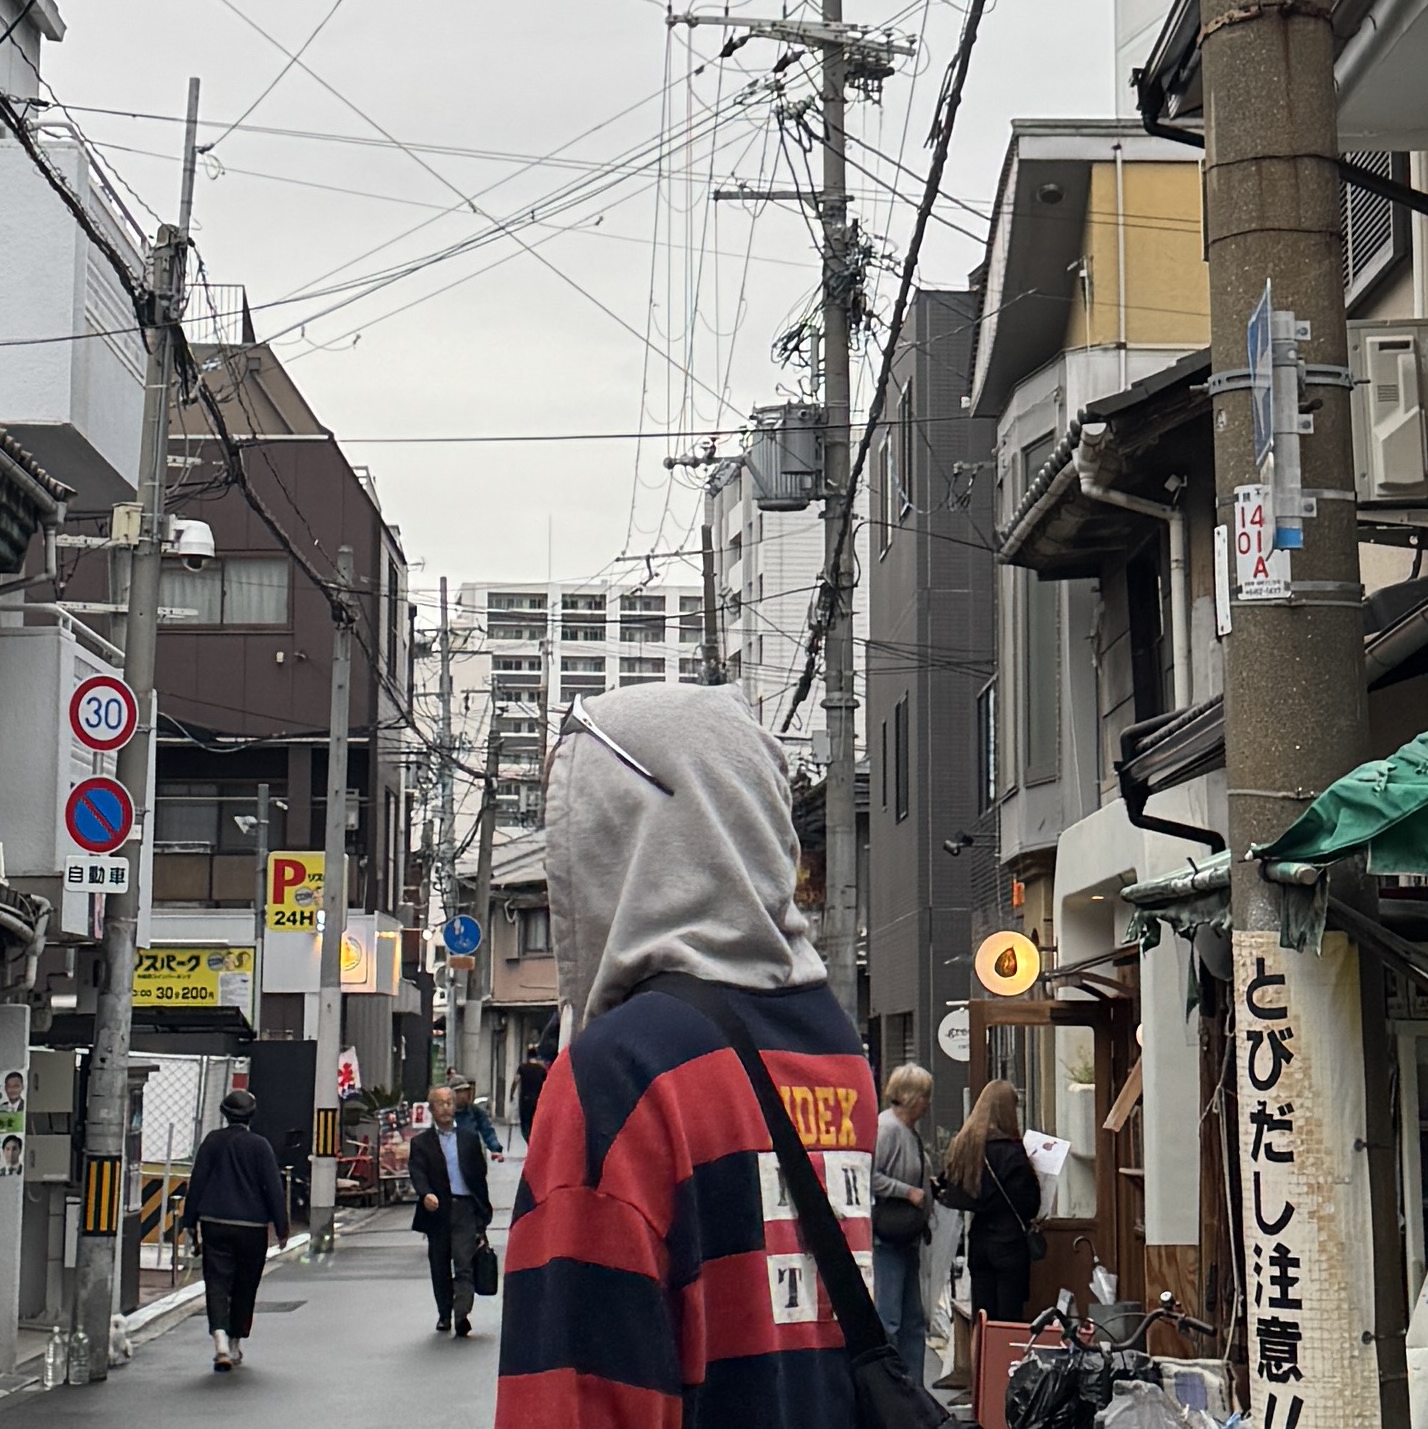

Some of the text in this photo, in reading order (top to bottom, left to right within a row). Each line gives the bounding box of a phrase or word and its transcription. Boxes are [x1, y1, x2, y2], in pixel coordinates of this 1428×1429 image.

[1253, 556, 1269, 578] A
[85, 697, 122, 730] 30
[68, 865, 126, 885] 自動車
[273, 859, 307, 904] P
